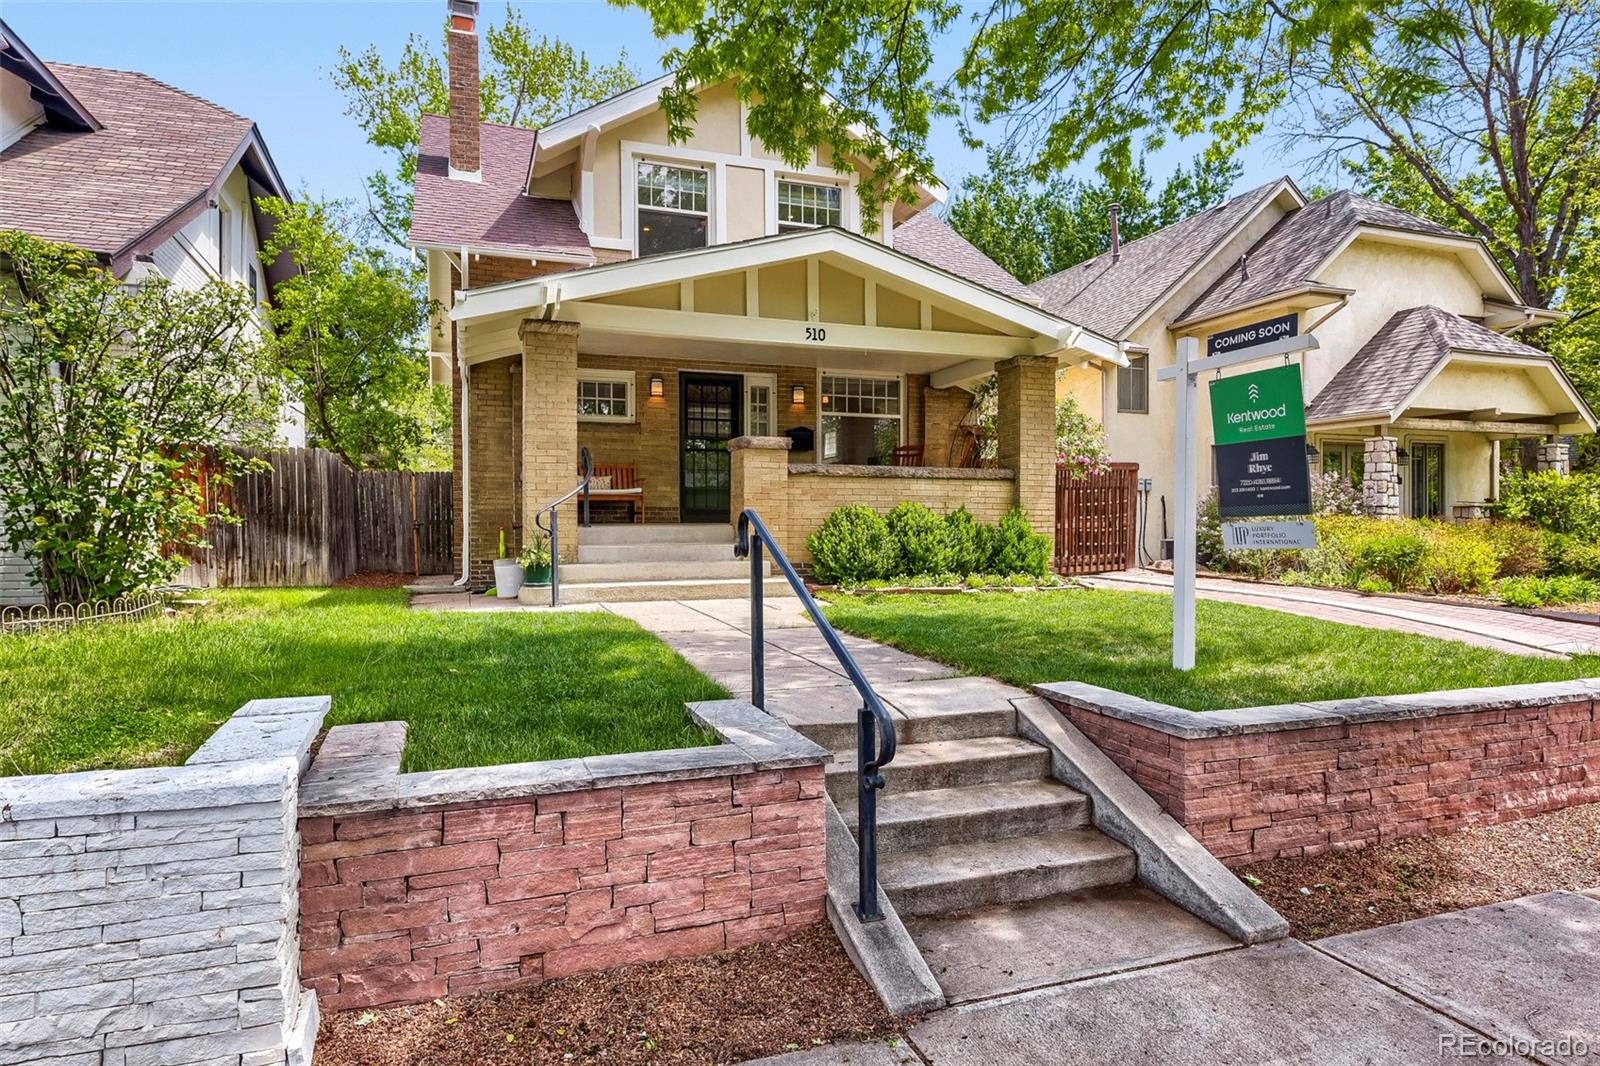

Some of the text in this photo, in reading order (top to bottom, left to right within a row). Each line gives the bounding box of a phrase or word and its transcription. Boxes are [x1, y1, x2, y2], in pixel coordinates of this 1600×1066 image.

[805, 327, 826, 341] 510
[1214, 322, 1290, 348] COMING SOON
[1227, 403, 1286, 424] Kentwood
[1254, 424, 1276, 432] Estate
[1249, 451, 1269, 462] Jim
